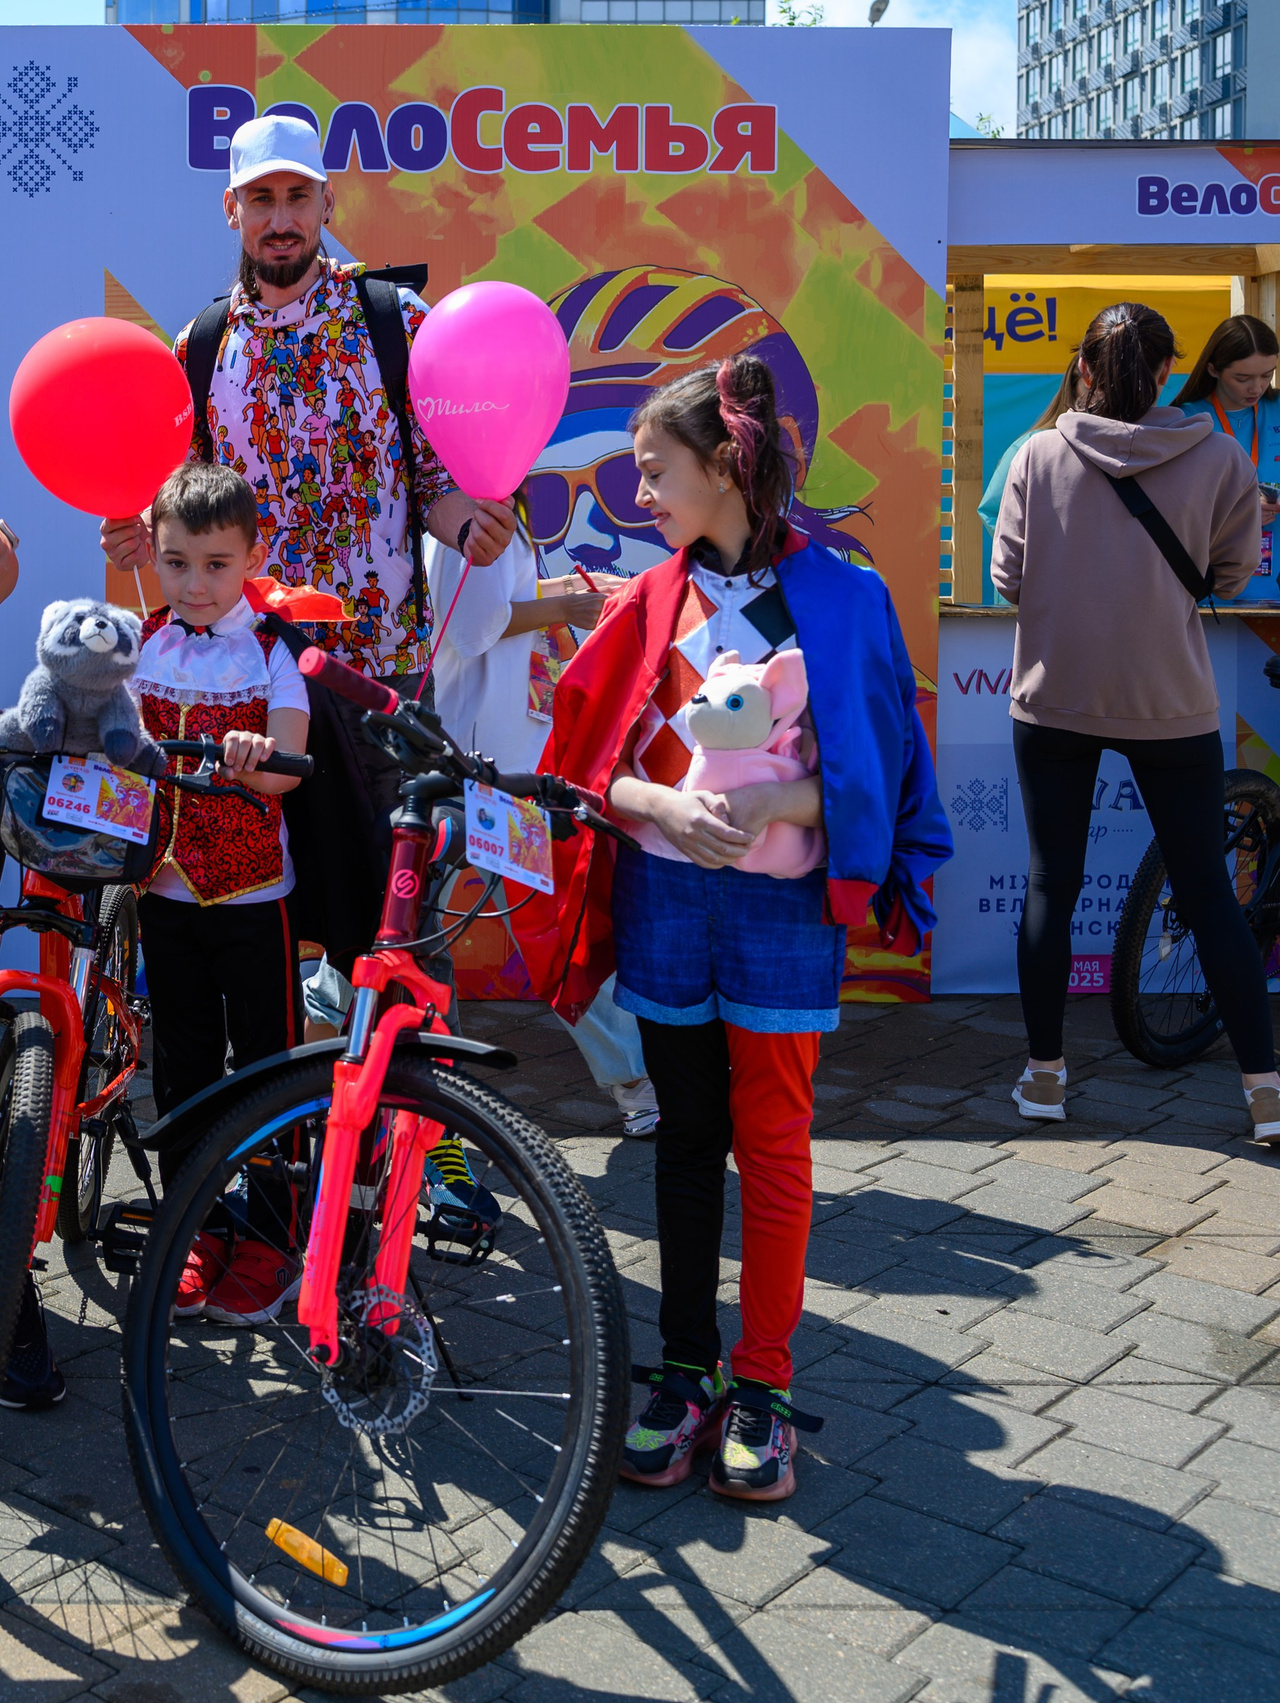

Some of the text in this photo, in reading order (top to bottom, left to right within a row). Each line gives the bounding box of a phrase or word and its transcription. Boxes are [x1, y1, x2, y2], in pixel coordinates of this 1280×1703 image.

[185, 84, 778, 174] ВлоСемья
[47, 796, 91, 814] 06246
[468, 834, 505, 858] 06007
[1073, 961, 1100, 972] МАЯ
